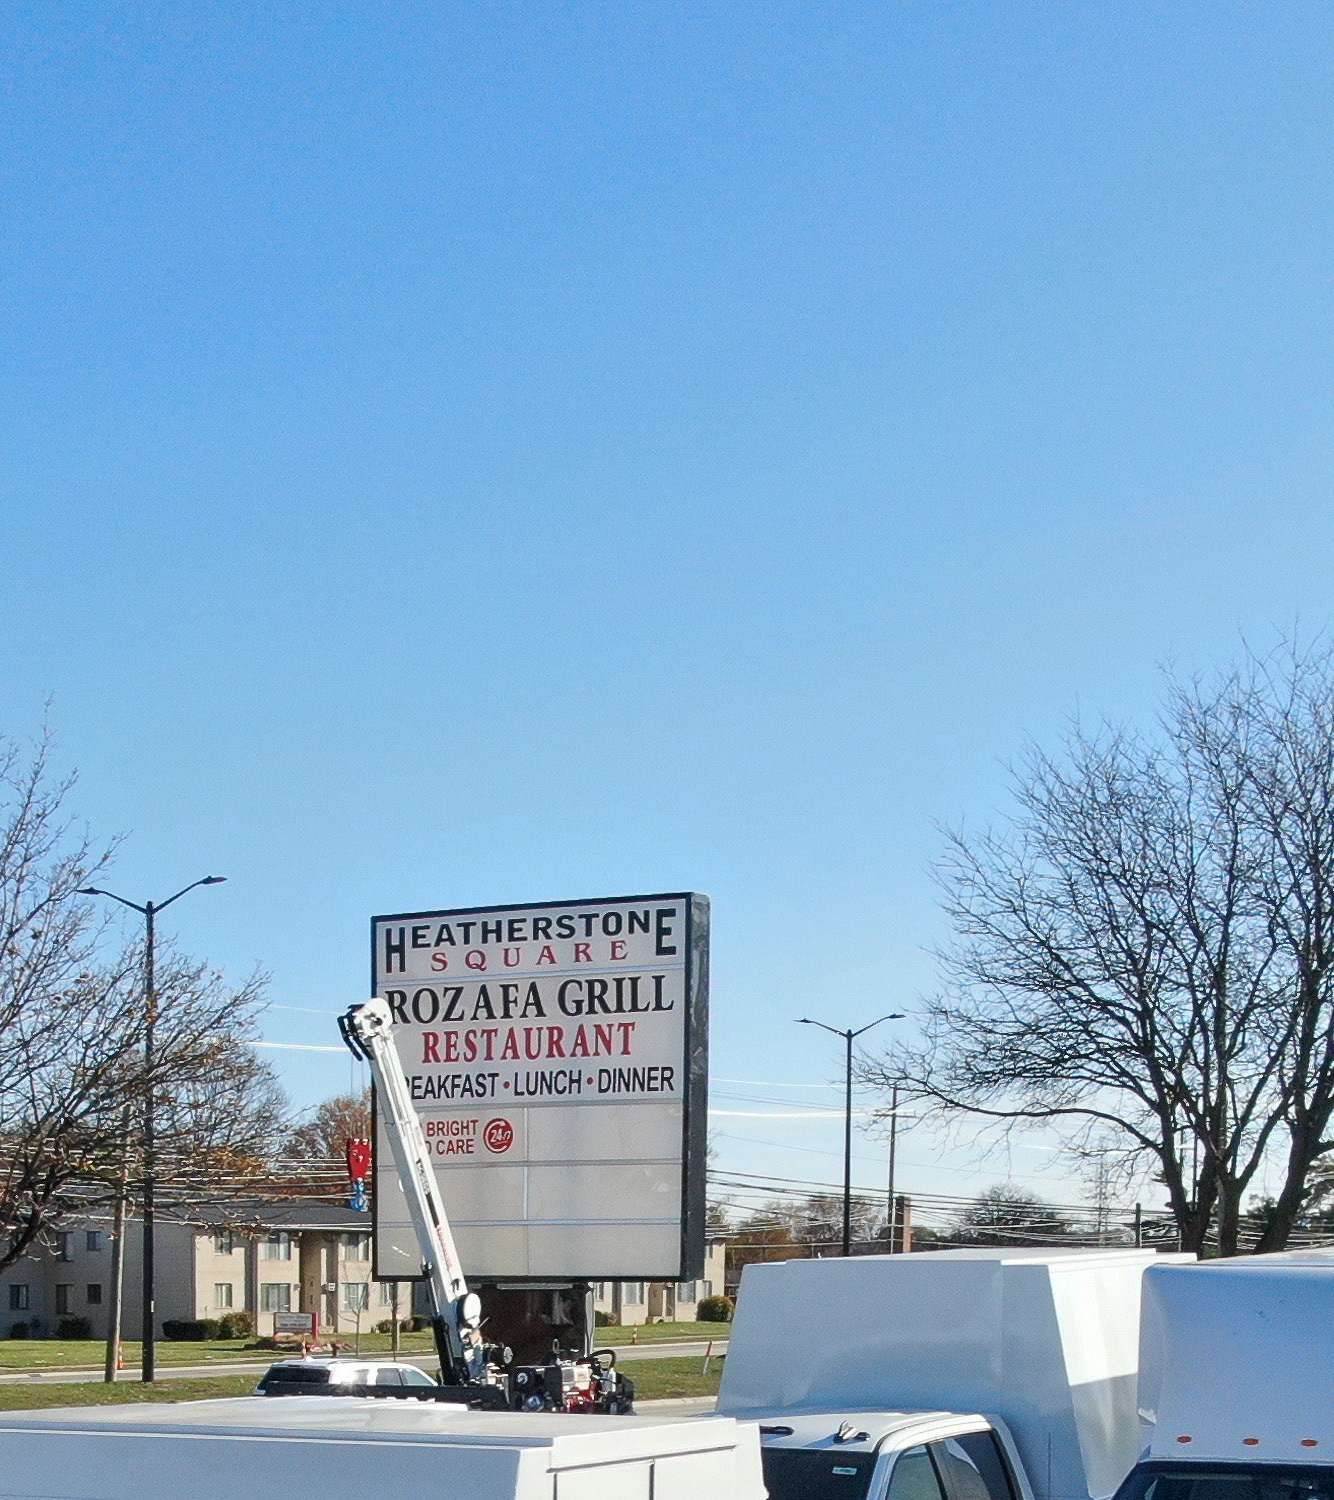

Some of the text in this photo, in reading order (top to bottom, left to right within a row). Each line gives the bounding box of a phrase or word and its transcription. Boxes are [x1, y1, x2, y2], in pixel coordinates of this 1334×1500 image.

[385, 908, 677, 973] HEATHERSTONE
[430, 940, 629, 972] SQUARE
[385, 974, 674, 1025] ROZAFA GRILL
[421, 1021, 636, 1064] RESTAURANT
[404, 1066, 675, 1100] EAKFAST LUNCH DINNER
[426, 1119, 479, 1138] BRIGHT
[436, 1138, 475, 1155] CARE
